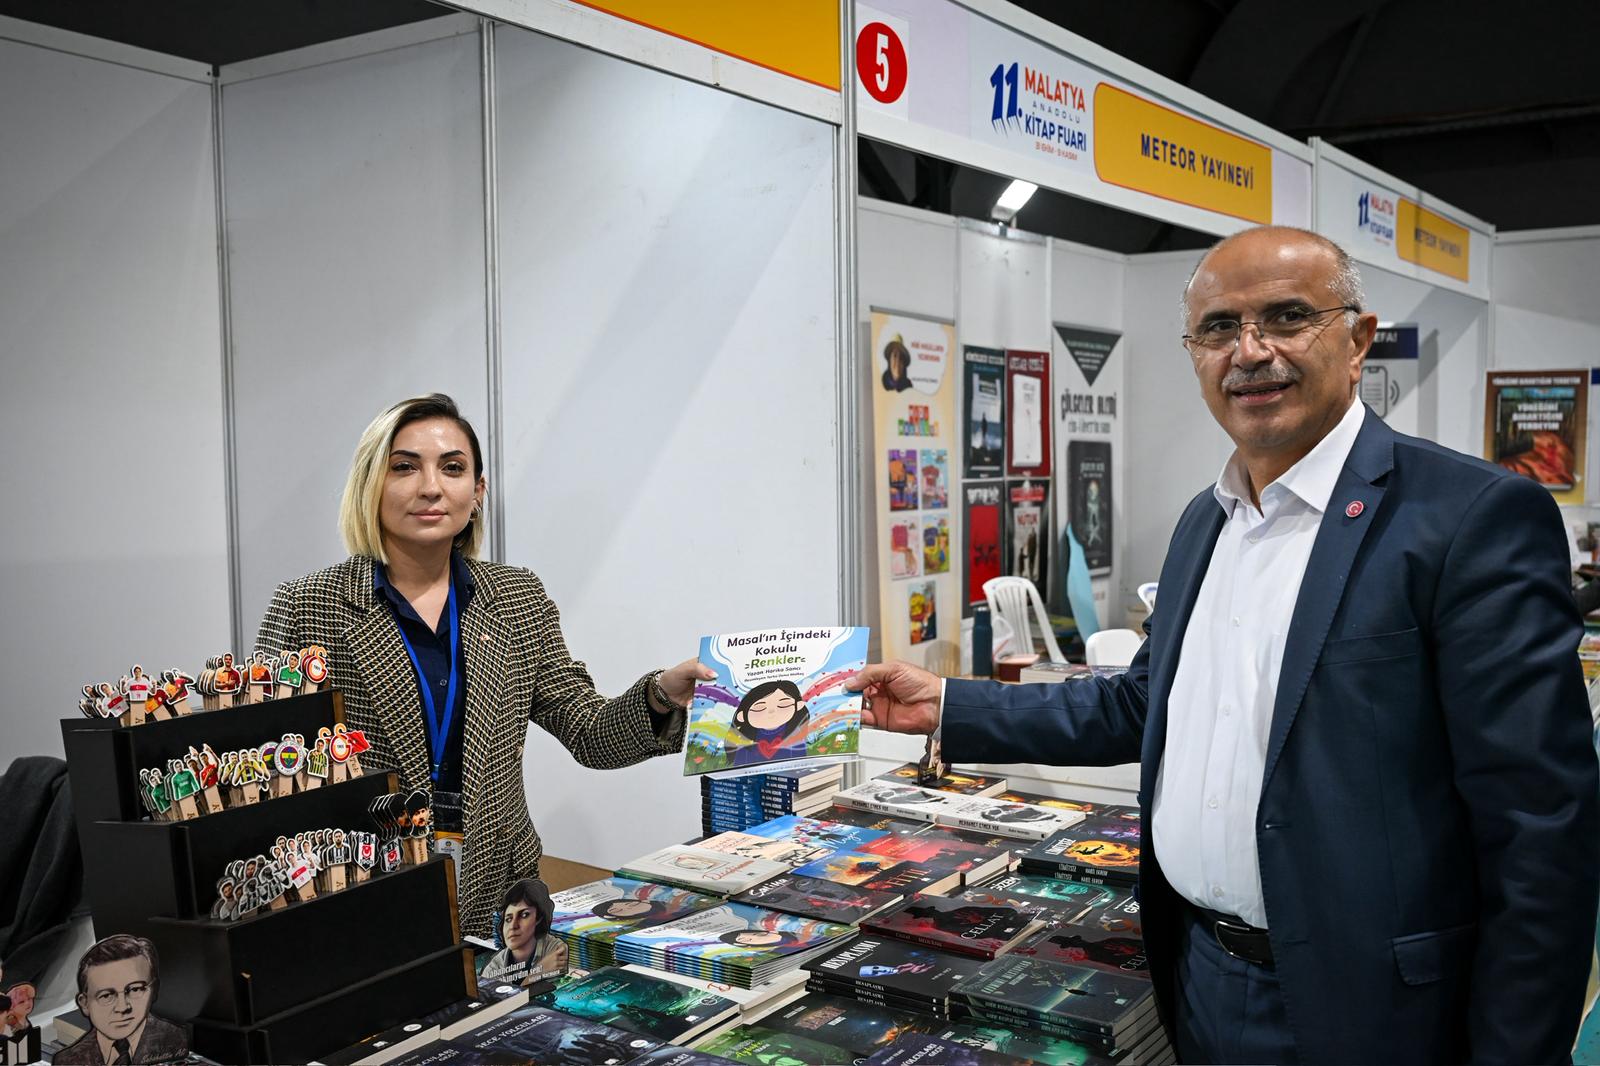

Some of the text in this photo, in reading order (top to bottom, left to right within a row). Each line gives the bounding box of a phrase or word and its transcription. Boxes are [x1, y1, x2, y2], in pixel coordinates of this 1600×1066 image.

[875, 33, 890, 92] 5
[990, 62, 1022, 121] 11.
[1025, 66, 1085, 112] MALATYA
[1032, 100, 1081, 124] ANADOLU
[1025, 112, 1087, 152] KİTAP FUARI
[1141, 133, 1254, 190] METEOR YAYINEVİ
[1373, 331, 1398, 343] EFA!
[780, 629, 831, 643] İçindeki
[750, 655, 801, 669] Renkler
[755, 644, 797, 656] Kokulu
[960, 913, 1004, 939] CELLAT
[1119, 954, 1147, 971] CELL
